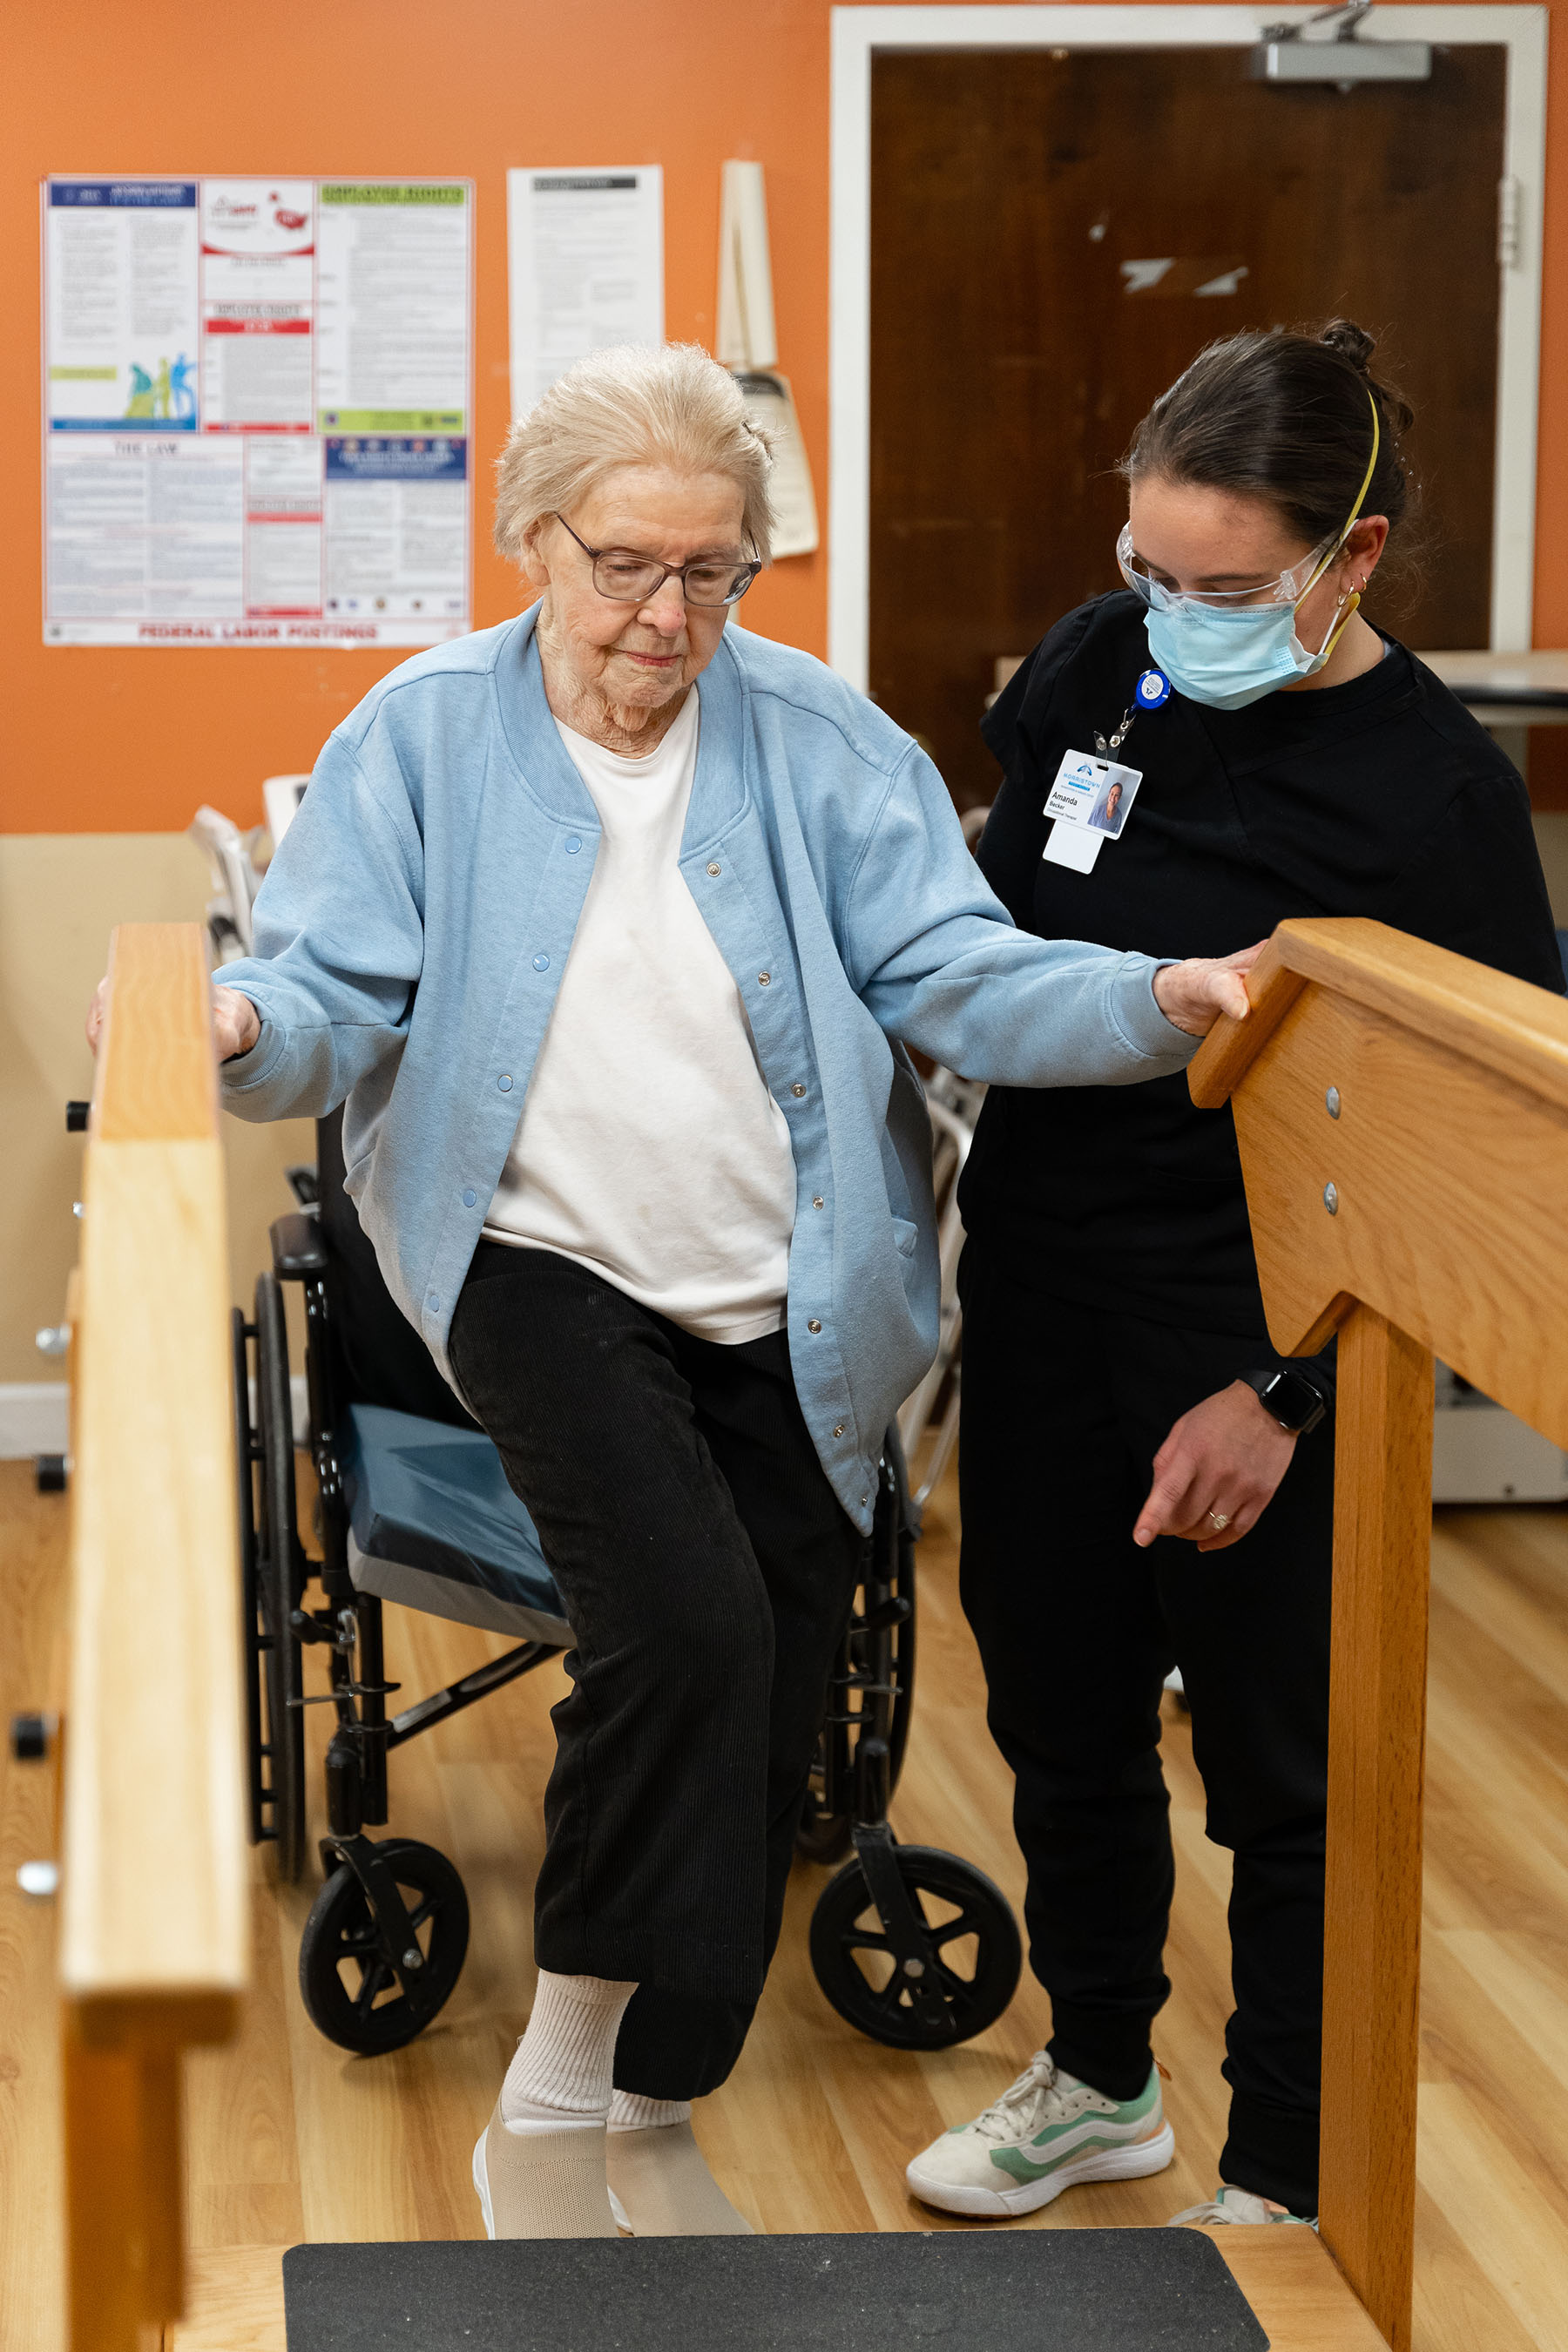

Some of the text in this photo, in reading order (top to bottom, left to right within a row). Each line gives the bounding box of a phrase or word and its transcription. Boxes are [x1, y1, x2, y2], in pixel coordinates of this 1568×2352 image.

[138, 623, 378, 639] FEDERAL LABOR POSTINGS
[1064, 773, 1100, 788] MORRISTOWN
[1049, 801, 1065, 810] Becker
[1052, 791, 1078, 806] Amanda
